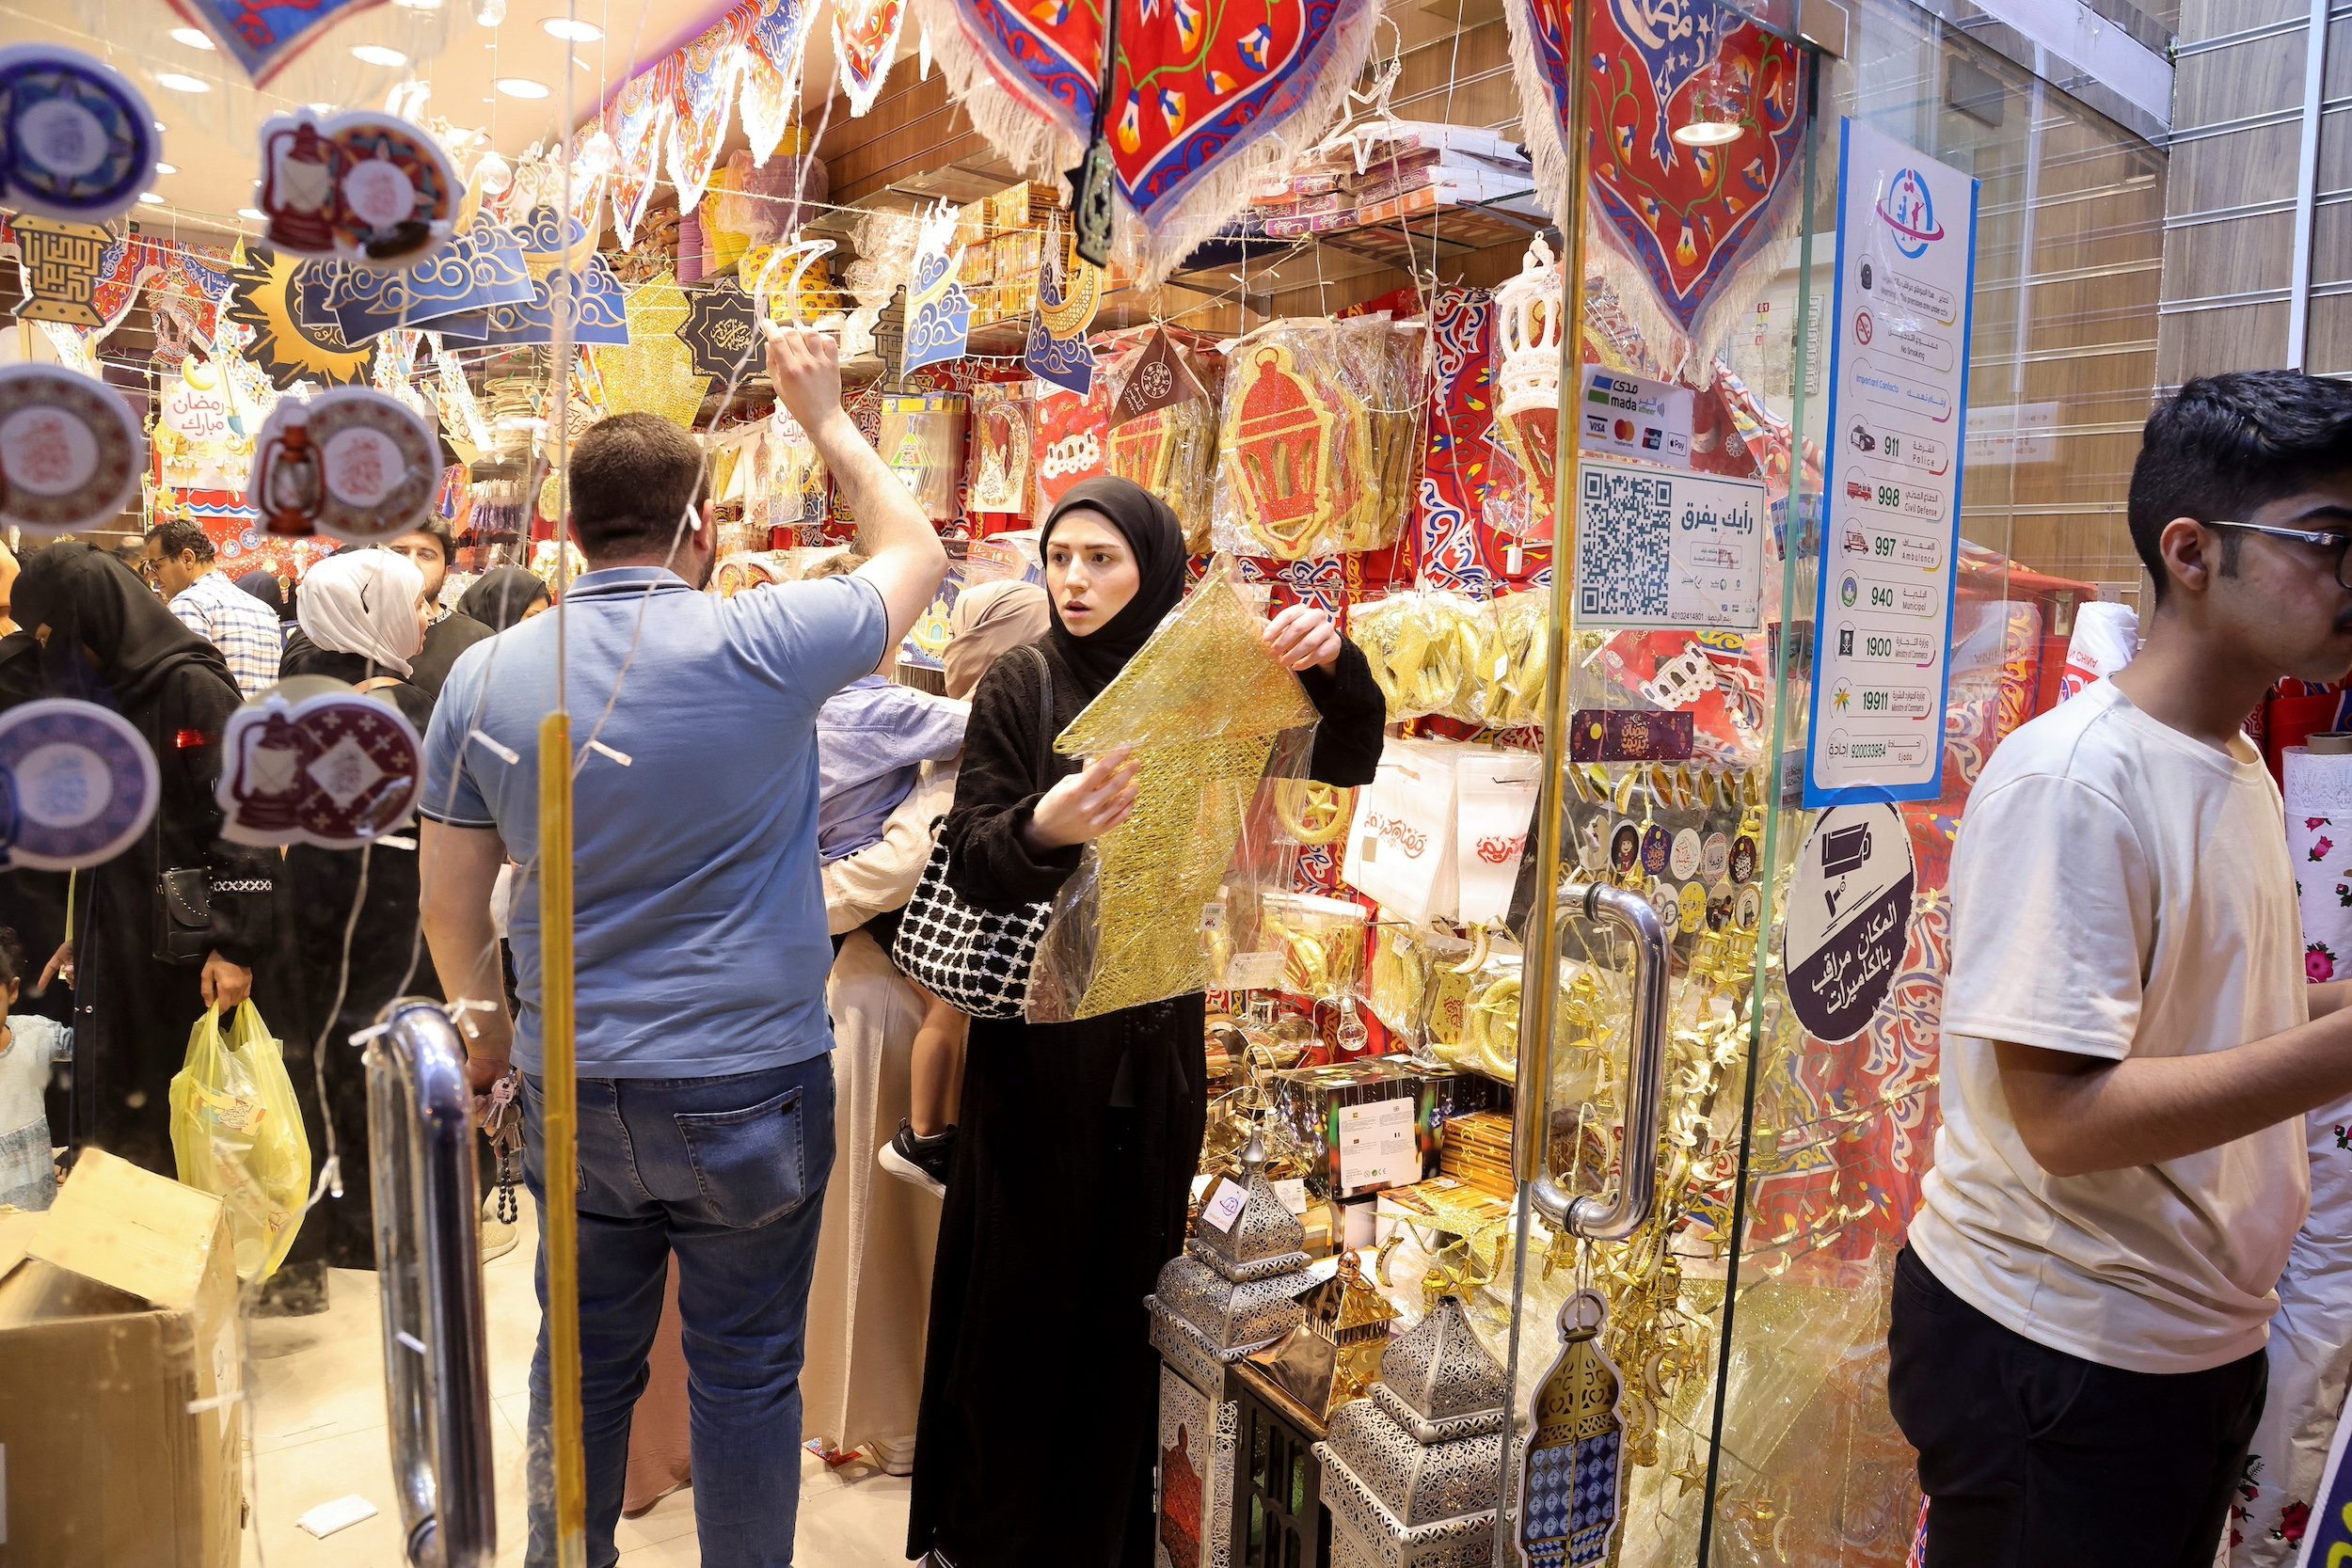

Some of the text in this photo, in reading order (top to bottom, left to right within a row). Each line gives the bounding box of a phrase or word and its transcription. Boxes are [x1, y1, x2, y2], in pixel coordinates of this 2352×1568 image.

[1907, 346, 1926, 361] Smoking
[1613, 380, 1639, 395] مدى
[1856, 374, 1899, 393] Important Contacts
[173, 391, 225, 414] رمضان
[1611, 396, 1637, 411] mada
[181, 414, 225, 436] مبارك
[1590, 420, 1605, 433] VISA
[1675, 439, 1685, 451] Pay
[1884, 436, 1899, 457] 911
[1913, 453, 1935, 467] Police
[1878, 485, 1899, 507] 998
[1681, 500, 1754, 535] رأيك يفرق
[1916, 505, 1937, 517] Defense
[1875, 536, 1897, 557] 997
[1901, 552, 1934, 563] Ambulance
[1871, 586, 1894, 608] 940
[1902, 601, 1927, 612] Municipal
[1867, 637, 1892, 657] 1900
[1863, 690, 1888, 710] 19911
[1811, 899, 1899, 995] المكان مراقب
[1826, 943, 1893, 1015] بالكاميرات
